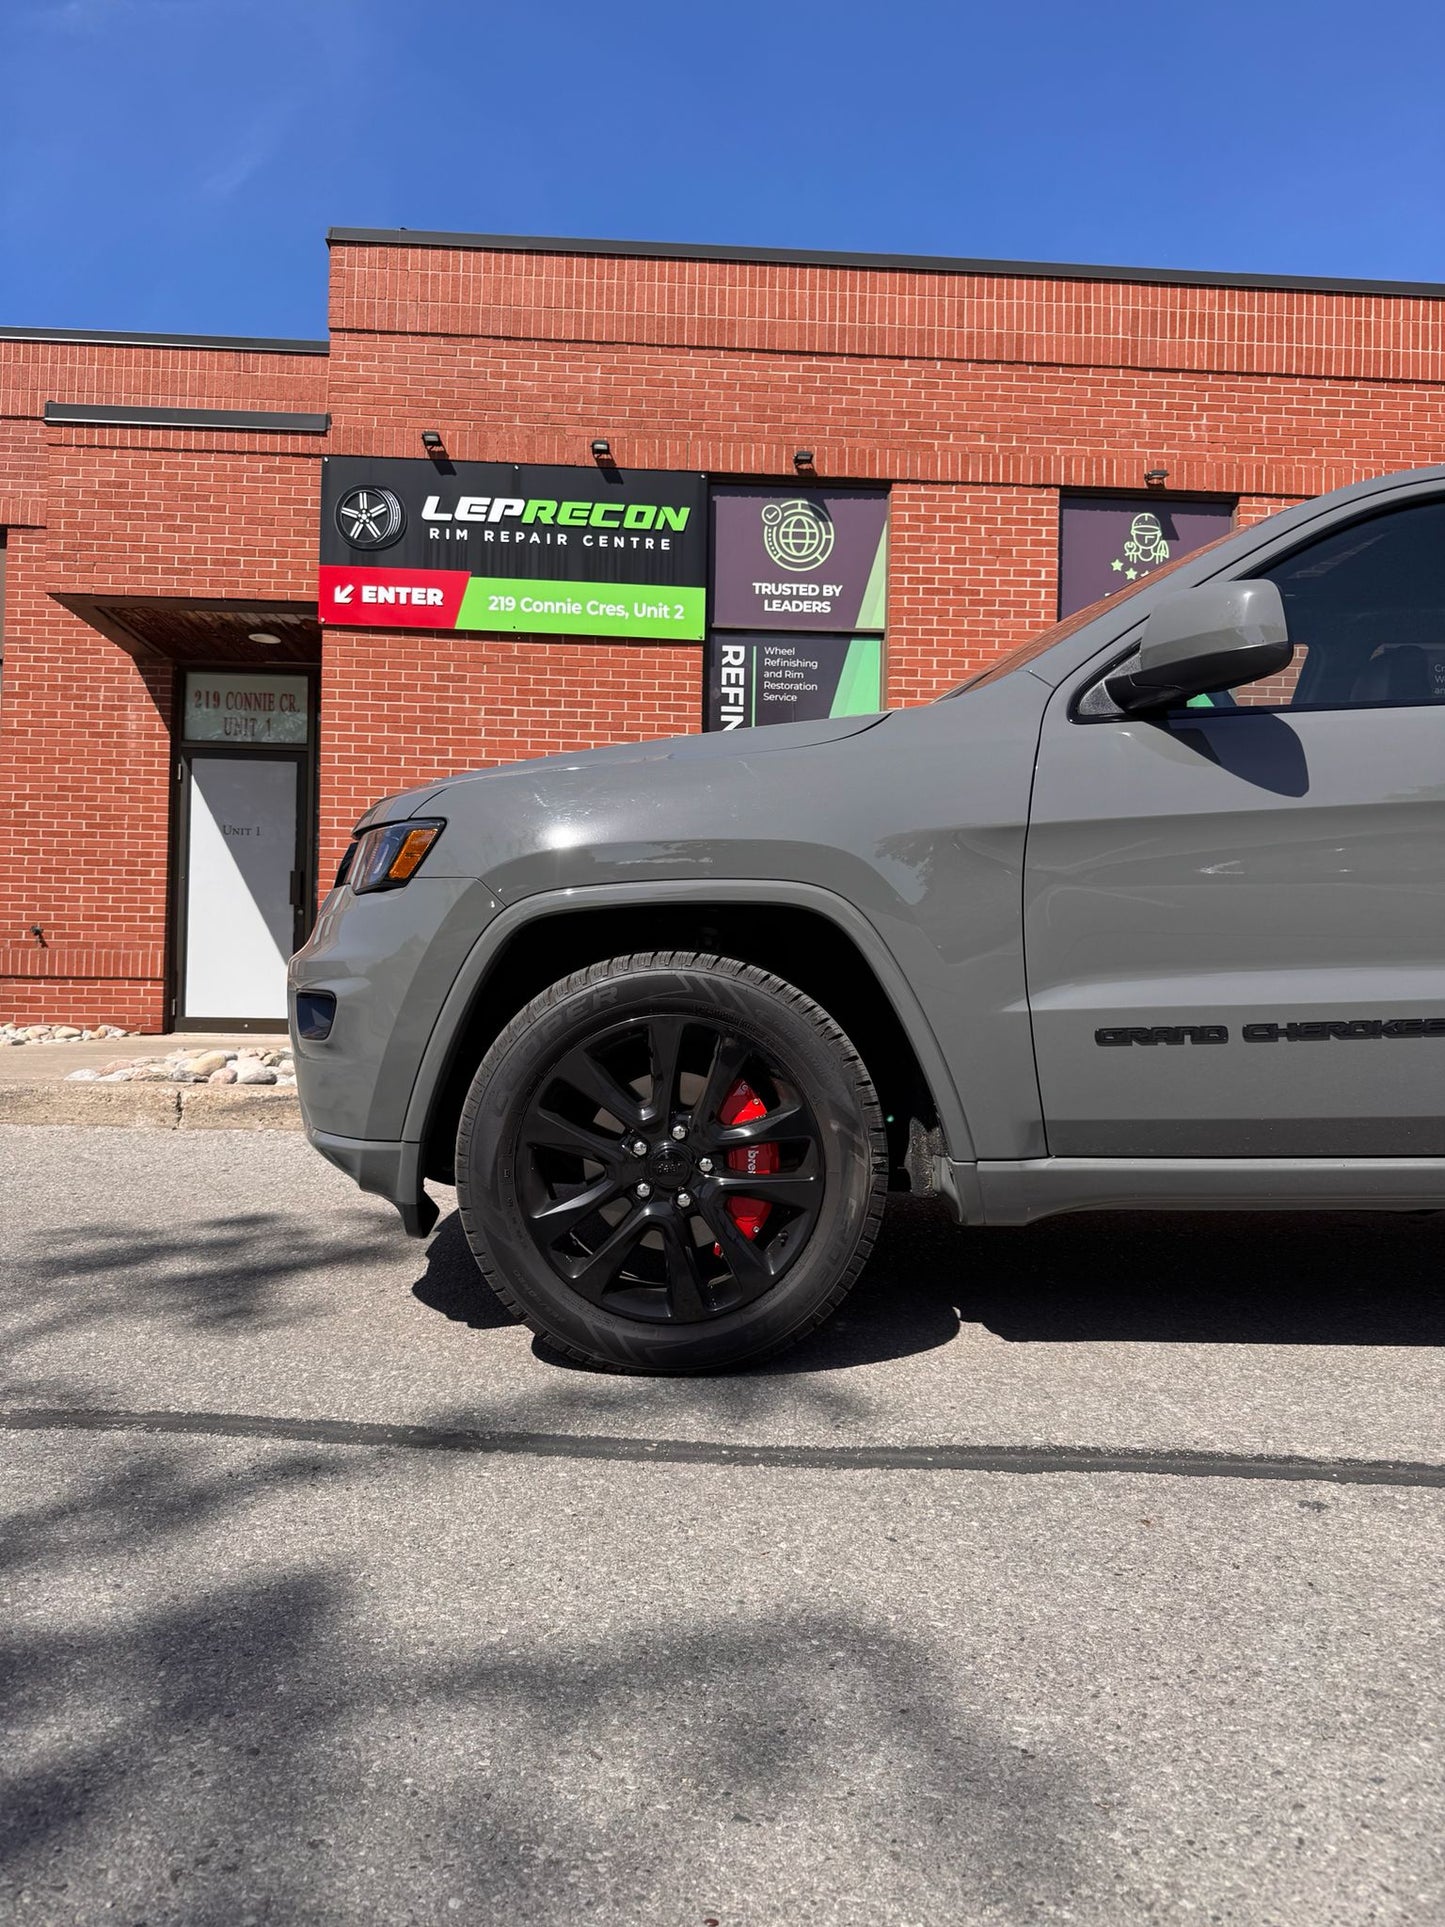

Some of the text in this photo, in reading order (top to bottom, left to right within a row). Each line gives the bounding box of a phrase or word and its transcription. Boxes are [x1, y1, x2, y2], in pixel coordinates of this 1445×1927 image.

[421, 495, 691, 532] LEPRECON
[429, 528, 671, 551] RIM REPAIR CENTRE
[361, 585, 444, 607] ENTER
[752, 582, 843, 597] TRUSTED BY
[488, 596, 685, 620] 219 Connie Cres, Unit 2
[764, 600, 831, 613] LEADERS
[764, 646, 796, 656] Wheel
[764, 658, 818, 670] Refinishing
[764, 670, 804, 679] and Rim
[720, 645, 745, 732] REFIN
[764, 681, 818, 691] Restoration
[194, 690, 220, 709] 219
[226, 691, 276, 712] CONNIE
[763, 693, 798, 702] Service
[224, 717, 272, 737] UNIT 1
[256, 826, 261, 836] 1
[1094, 1025, 1229, 1047] GRAND
